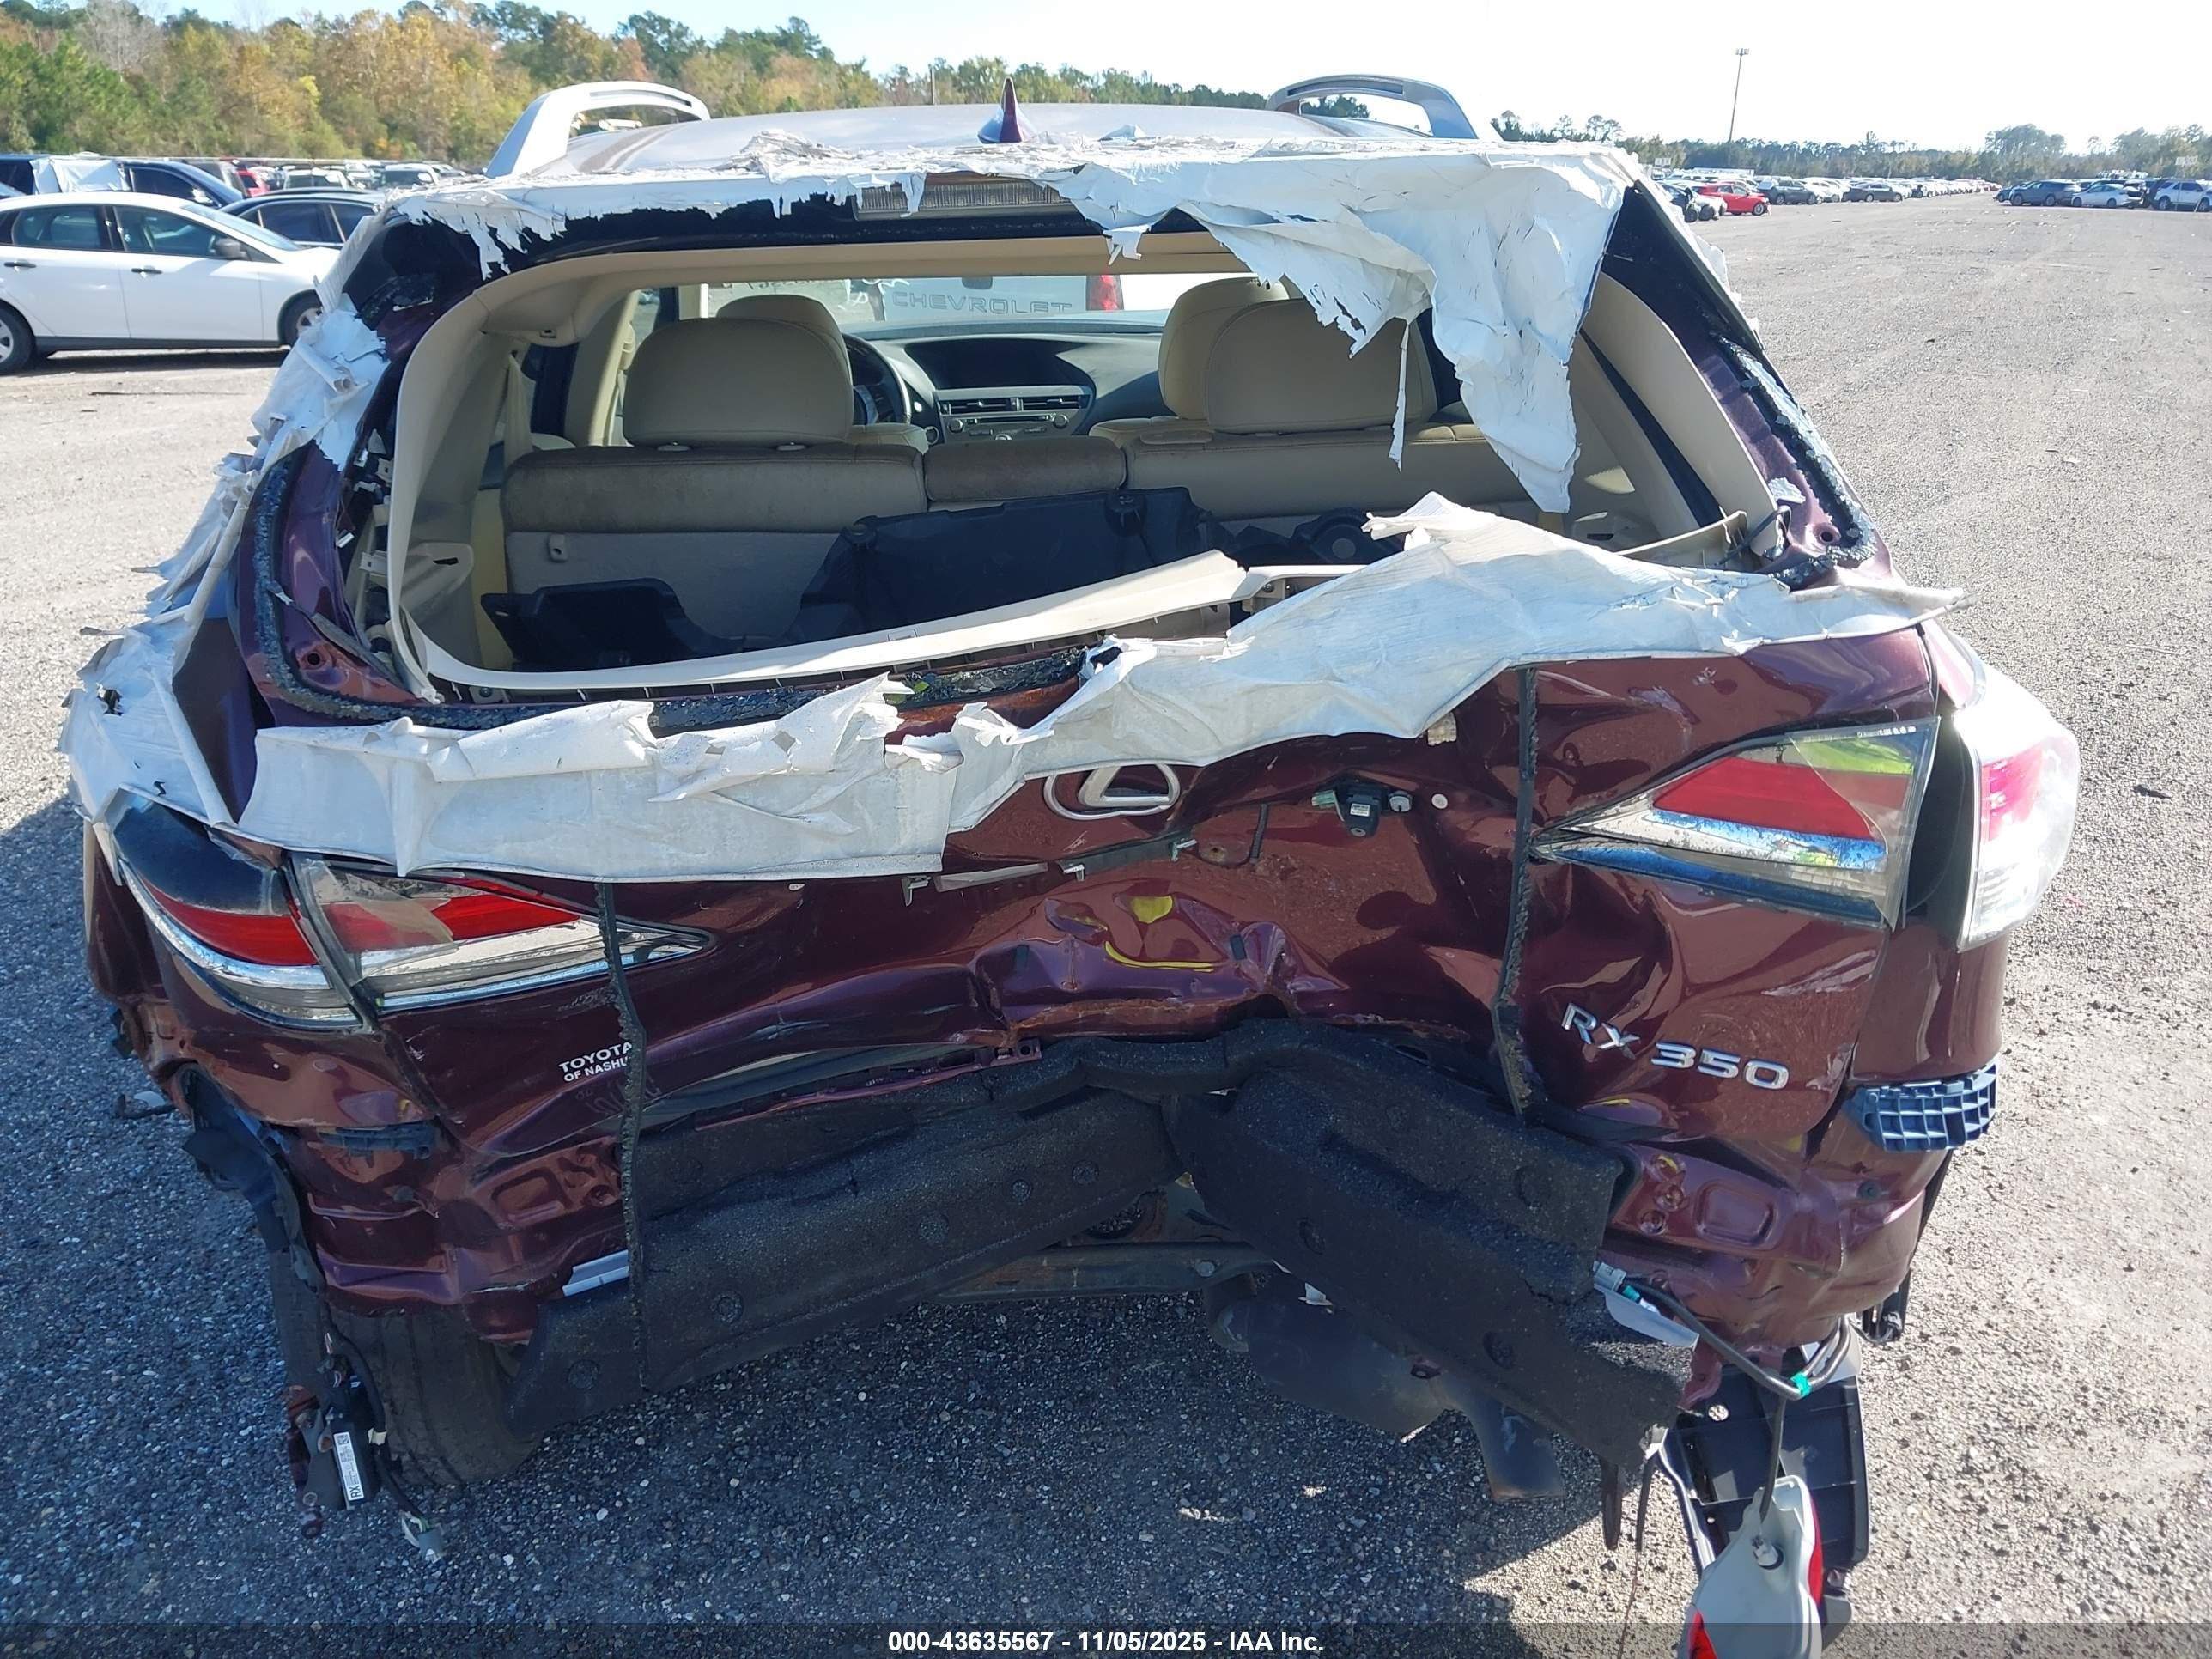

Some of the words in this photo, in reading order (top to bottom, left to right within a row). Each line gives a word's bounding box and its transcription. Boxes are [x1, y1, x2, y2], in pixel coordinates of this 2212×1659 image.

[893, 291, 1073, 313] CHEVROLET
[559, 1042, 633, 1073] TOYOTA
[1561, 1002, 1641, 1060] RX
[1650, 1042, 1790, 1090] 350
[563, 1071, 583, 1082] OF
